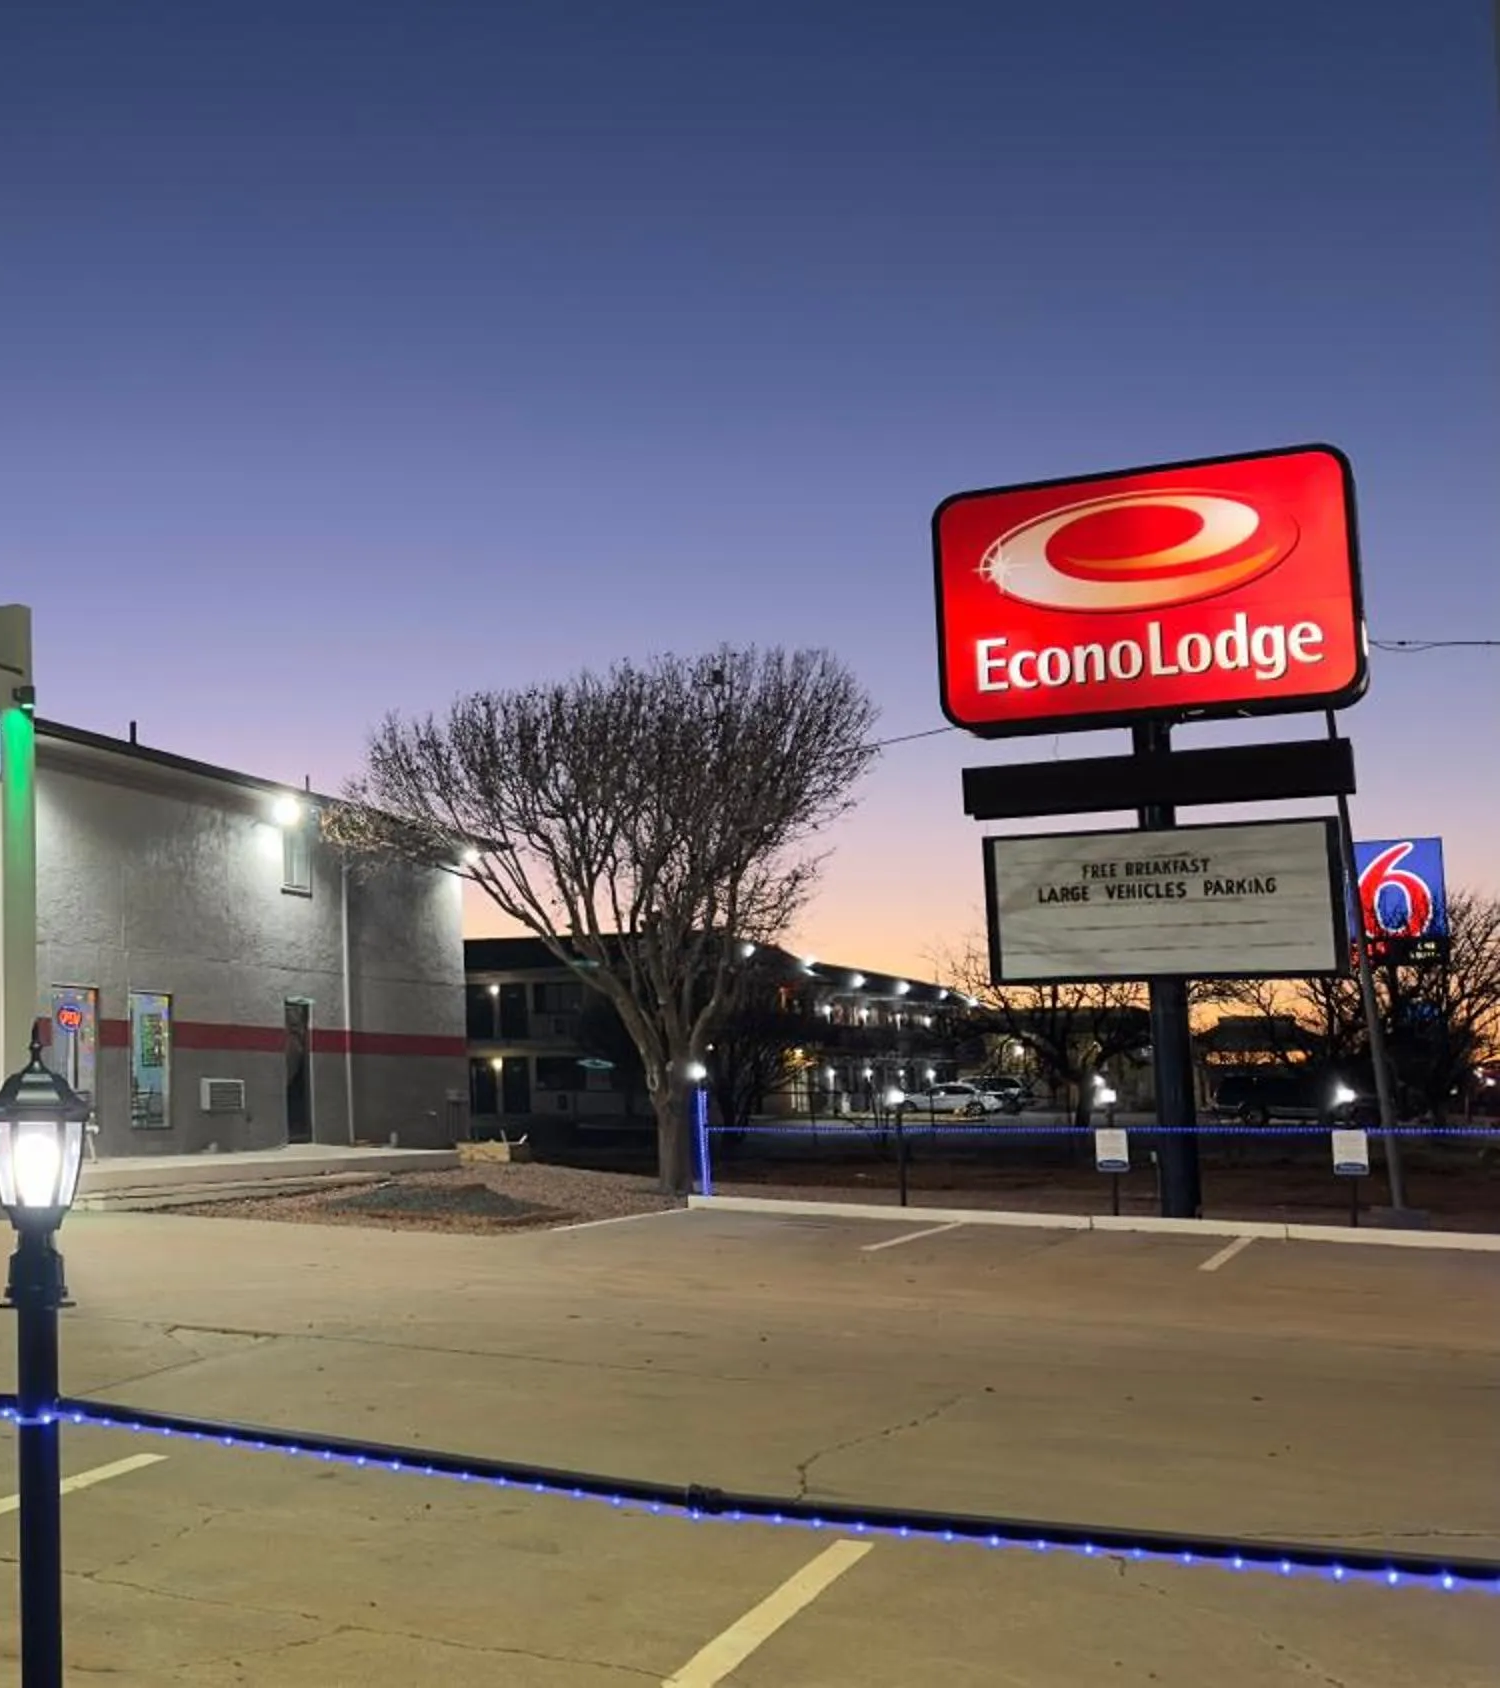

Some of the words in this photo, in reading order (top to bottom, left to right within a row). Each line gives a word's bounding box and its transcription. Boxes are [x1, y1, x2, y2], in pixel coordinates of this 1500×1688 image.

[975, 612, 1325, 692] EconoLodge
[1038, 885, 1090, 903] LARGE
[1104, 881, 1187, 900] VEHICLES
[1203, 877, 1277, 896] PARKING
[1082, 862, 1118, 879] FREE
[1125, 858, 1210, 877] BREAKFAST
[1358, 841, 1433, 938] 6
